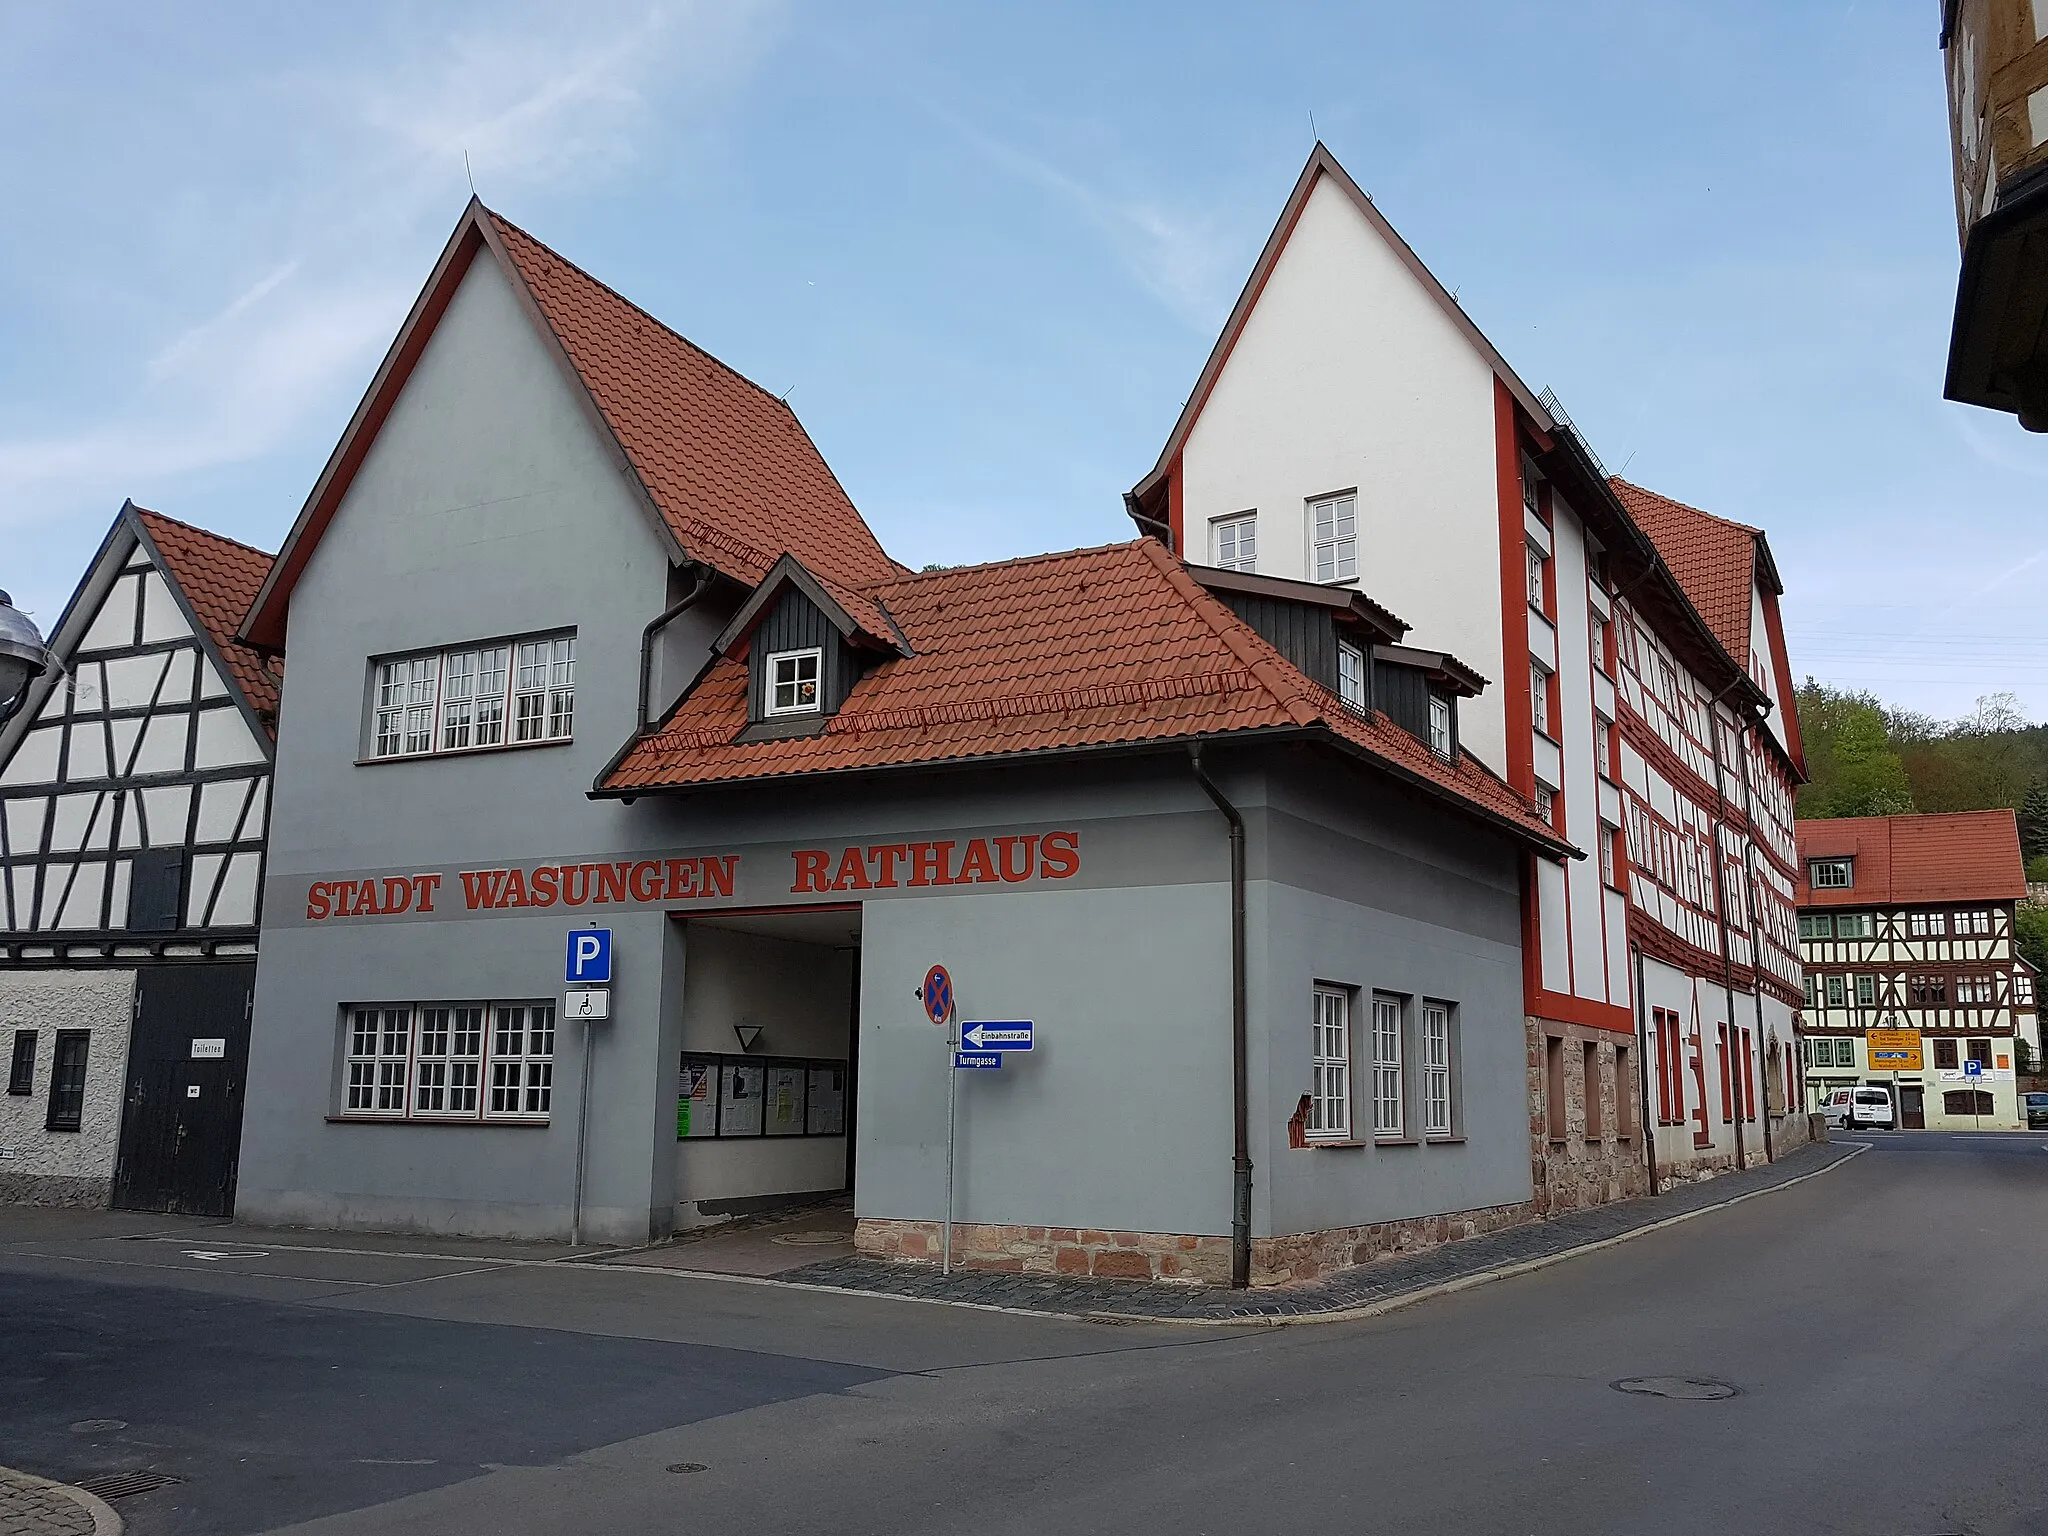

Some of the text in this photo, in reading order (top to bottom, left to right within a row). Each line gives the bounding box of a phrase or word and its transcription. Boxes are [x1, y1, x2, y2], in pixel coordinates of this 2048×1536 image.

[306, 831, 1080, 920] STADT WASUNGEN RATHAUS
[576, 936, 600, 975] P
[981, 1032, 1029, 1040] Einbahnstraße
[194, 1044, 221, 1052] Toiletten
[959, 1055, 996, 1067] Turmgasse
[1967, 1062, 1977, 1073] P
